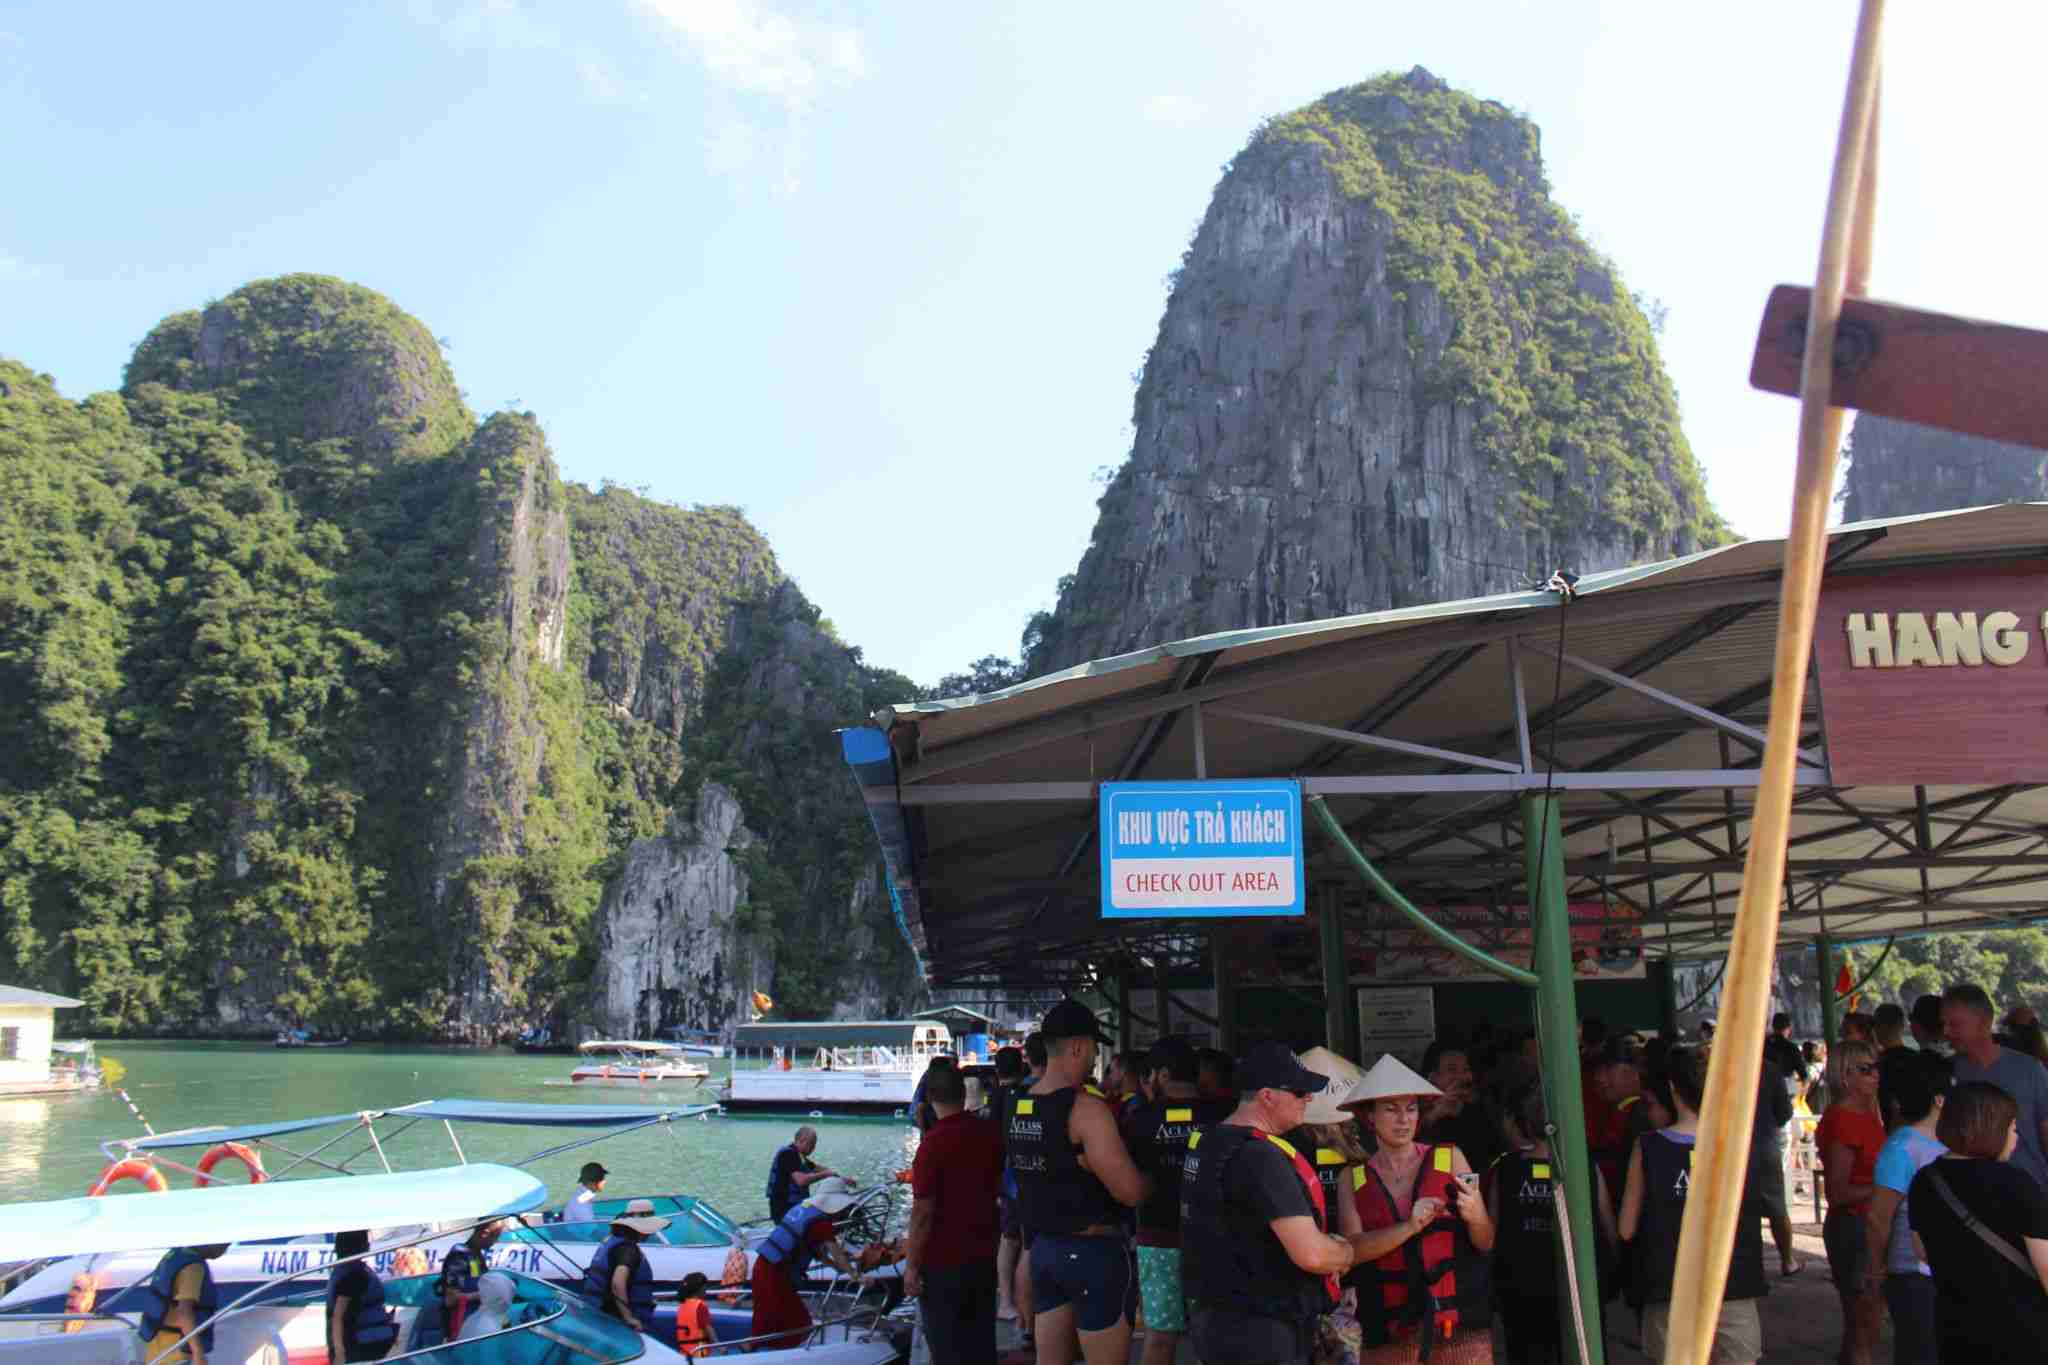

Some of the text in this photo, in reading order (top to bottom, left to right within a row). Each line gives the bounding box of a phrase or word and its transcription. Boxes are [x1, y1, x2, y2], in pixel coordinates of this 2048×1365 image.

[1847, 611, 2030, 668] HANG
[1118, 800, 1286, 852] KHU VỰC TRẢ KHÁCH
[1126, 871, 1280, 893] CHECK OUT AREA
[261, 1250, 309, 1274] NAM
